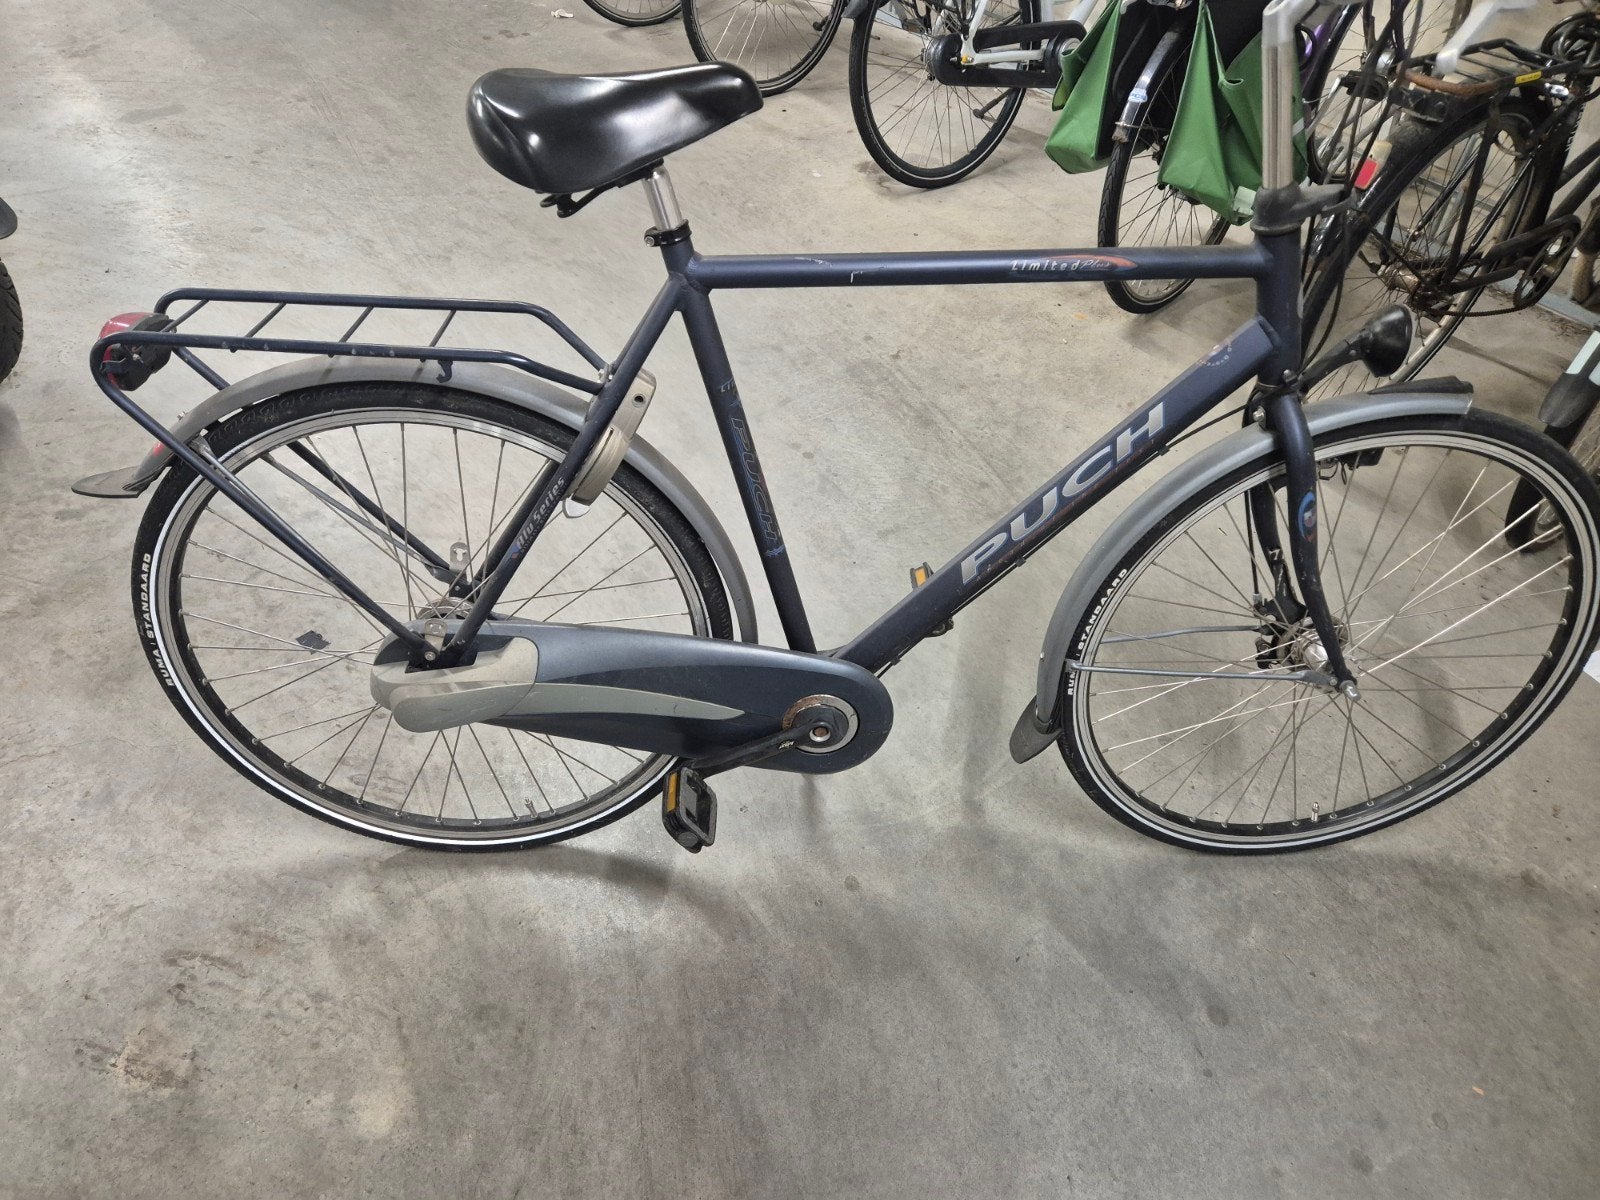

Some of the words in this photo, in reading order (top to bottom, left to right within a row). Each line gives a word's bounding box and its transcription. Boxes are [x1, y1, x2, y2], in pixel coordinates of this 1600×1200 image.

[1011, 259, 1080, 272] Limited
[516, 522, 534, 550] Alu
[533, 477, 565, 523] Series
[730, 417, 778, 541] PUCH
[960, 401, 1165, 586] PUCH
[139, 552, 155, 639] STANDAARD
[1067, 671, 1077, 696] RUM
[1077, 568, 1128, 650] STANDAARD
[152, 649, 176, 687] RUMA
